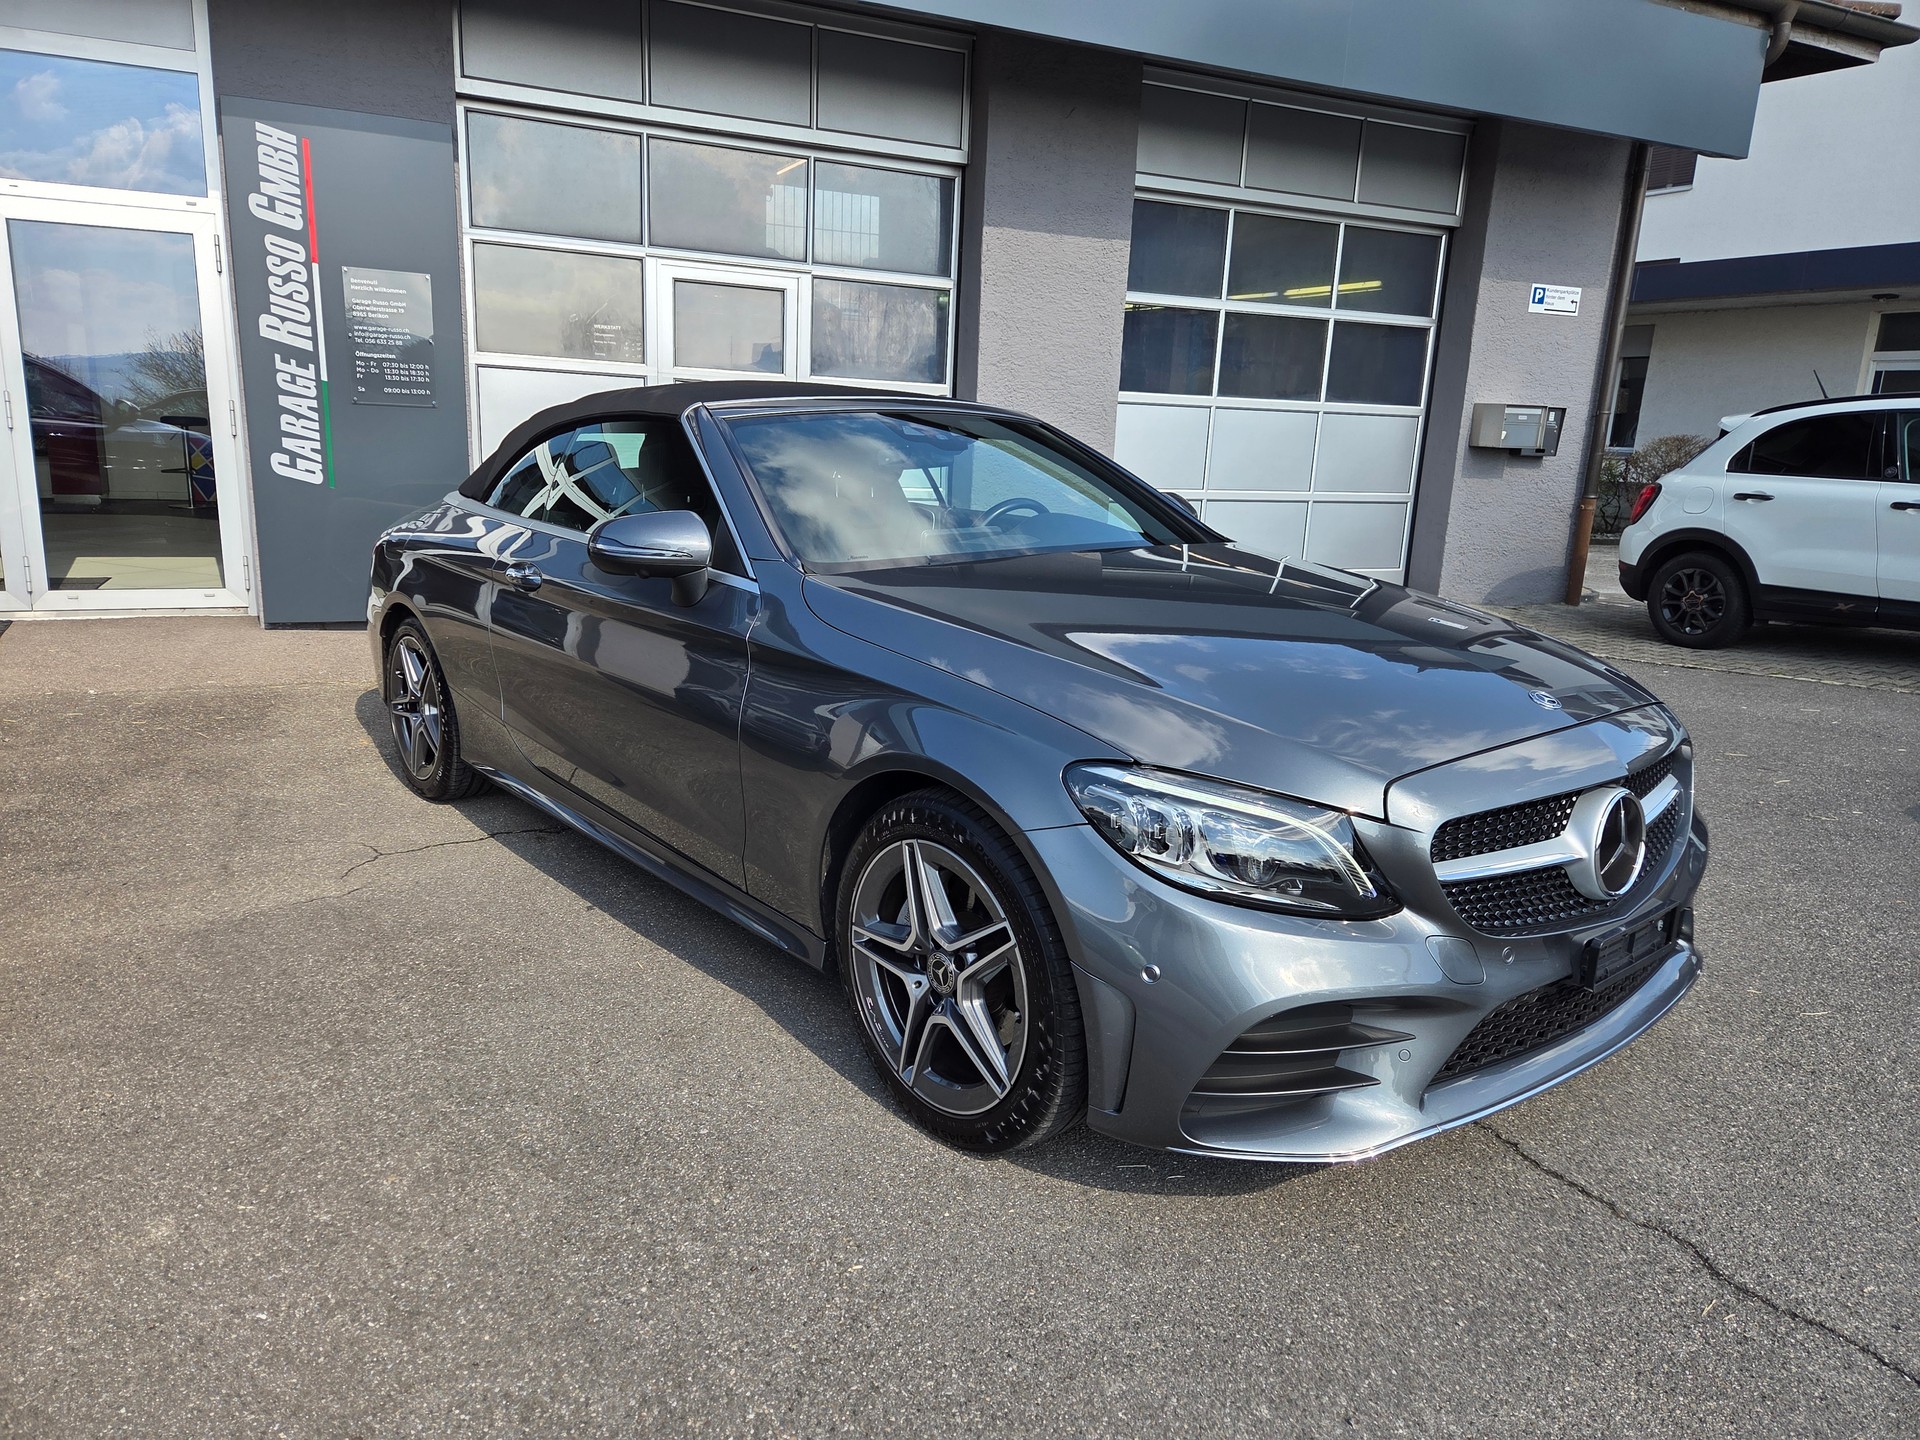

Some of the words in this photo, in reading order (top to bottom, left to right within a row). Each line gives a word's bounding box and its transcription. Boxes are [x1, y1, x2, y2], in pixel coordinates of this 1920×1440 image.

[350, 277, 378, 285] Benvenuti
[350, 284, 374, 292] Herzlich
[374, 286, 407, 295] willkommen
[1534, 288, 1544, 303] P
[351, 298, 372, 306] Garage
[389, 300, 407, 308] GmbH
[352, 304, 398, 314] Oberwilerstrasse
[367, 311, 389, 319] Berikon
[353, 325, 410, 334] www.garage-russo.ch
[355, 350, 397, 360] Öffnungszeiten
